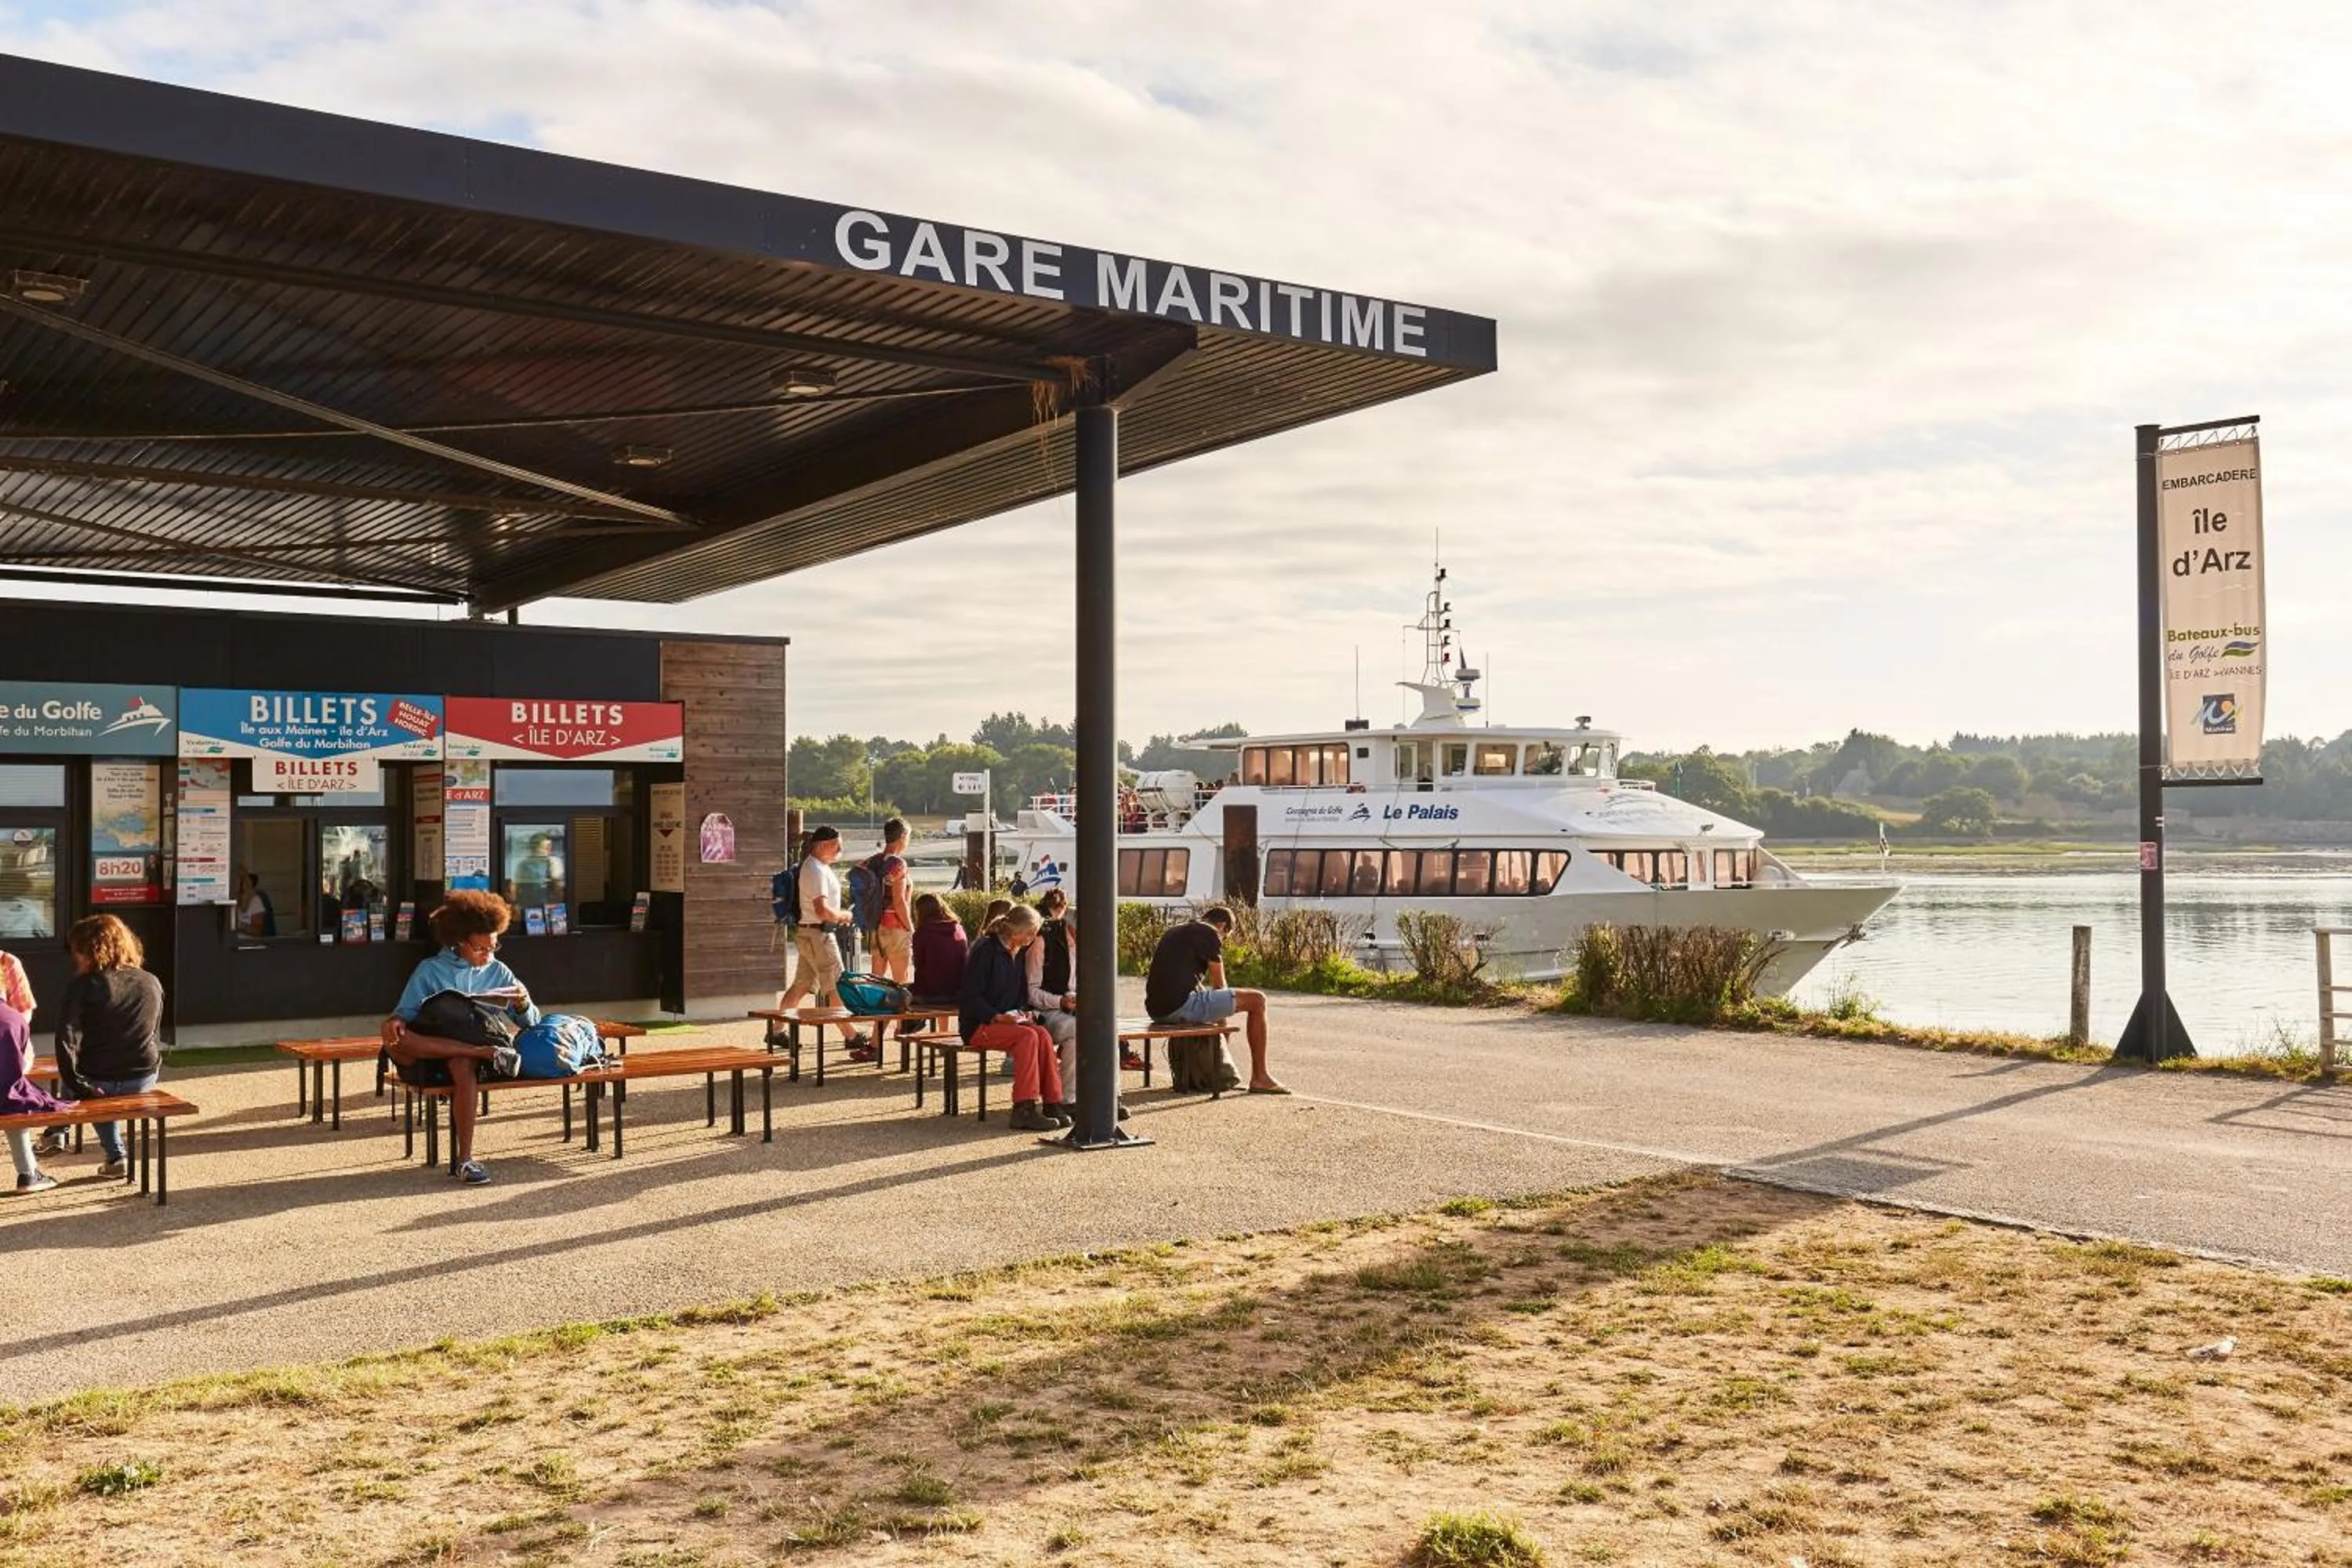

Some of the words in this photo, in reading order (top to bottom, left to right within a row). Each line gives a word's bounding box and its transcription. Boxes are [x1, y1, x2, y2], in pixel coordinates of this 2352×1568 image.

[835, 210, 1064, 300] GARE
[1098, 253, 1427, 357] MARITIME
[2162, 468, 2256, 490] EMBARCADERE
[2192, 508, 2227, 533] île
[2172, 548, 2252, 576] d'Arz
[2167, 622, 2260, 642] Bateaux-bus
[2168, 648, 2183, 661] du
[2188, 645, 2220, 664] Golfe
[14, 703, 37, 718] du
[42, 700, 102, 720] Golfe
[251, 695, 377, 725] BILLETS
[511, 702, 623, 725] BILLETS
[14, 725, 29, 736] du
[34, 725, 92, 737] Morbihan
[258, 726, 281, 735] aux
[285, 725, 327, 735] Moines
[356, 725, 388, 737] d'Arz
[528, 725, 550, 745] ÎLE
[556, 730, 606, 746] D'ARZ
[260, 737, 292, 748] Golfe
[296, 738, 310, 748] du
[314, 739, 370, 750] Morbihan
[275, 761, 358, 775] BILLETS
[288, 776, 303, 789] ÎLE
[308, 779, 344, 790] D'ARZ
[1383, 804, 1403, 819] Le
[1408, 804, 1458, 819] Palais
[100, 862, 141, 876] 8h20
